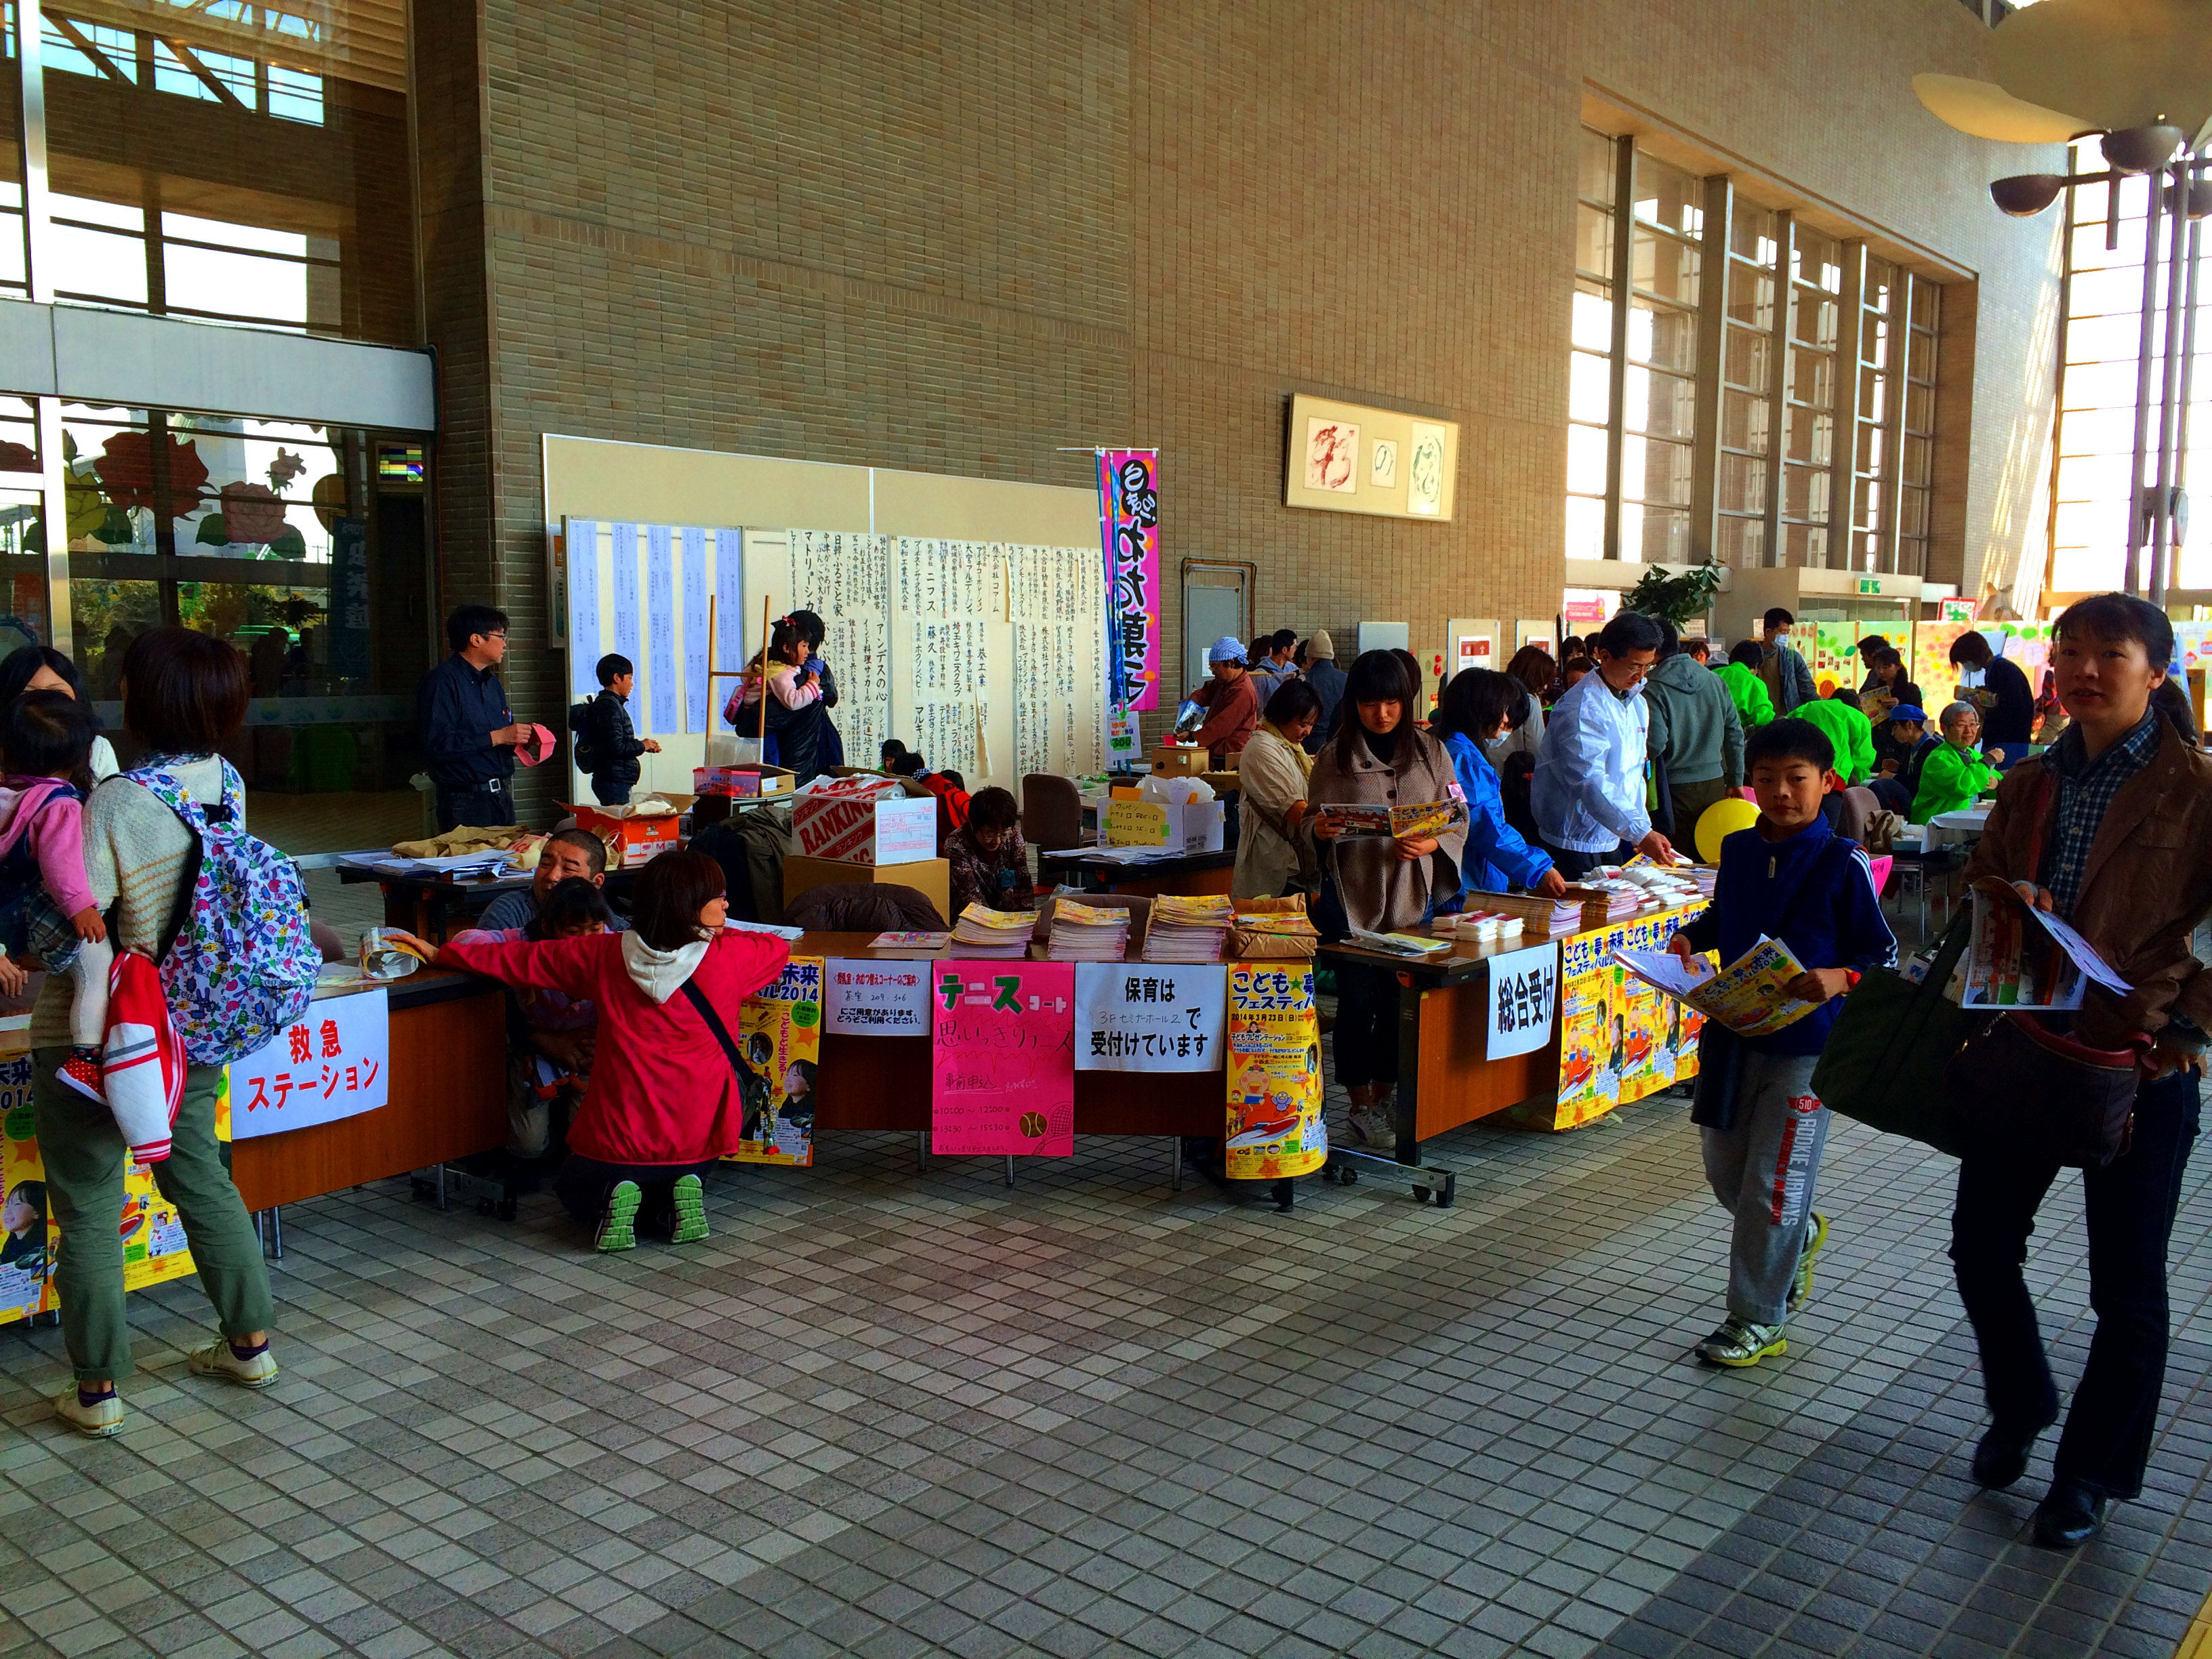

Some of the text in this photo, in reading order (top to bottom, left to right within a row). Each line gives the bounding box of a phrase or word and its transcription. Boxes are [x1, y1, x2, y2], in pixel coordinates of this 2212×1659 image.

[804, 531, 814, 611] マトリョーシカ
[927, 573, 935, 611] ニフス
[876, 623, 887, 701] アンデスの心
[863, 707, 874, 770] JR総連埼玉協
[793, 799, 819, 823] ランキング
[799, 800, 874, 855] RANKING
[836, 830, 863, 854] ランキング
[1564, 930, 1624, 964] こども 夢 未来
[1627, 925, 1647, 945] こども
[782, 963, 819, 985] 未来
[1125, 977, 1175, 1003] 保育は
[1233, 972, 1290, 994] こども
[758, 985, 819, 1001] ル2014
[938, 974, 1025, 1015] テニス
[1497, 964, 1553, 1034] 総合受付
[840, 1008, 916, 1016] にご用意があります。
[1099, 1010, 1116, 1025] 3F
[1186, 1007, 1201, 1030] で
[288, 1019, 342, 1065] 救急
[937, 1019, 1071, 1053] 思いっきりテニス
[1090, 1030, 1208, 1057] 受付けています
[247, 1057, 379, 1113] ステーション
[1799, 1099, 1812, 1110] 510
[1790, 1118, 1817, 1166] ROOKIE
[1781, 1169, 1807, 1226] AIRWAYS
